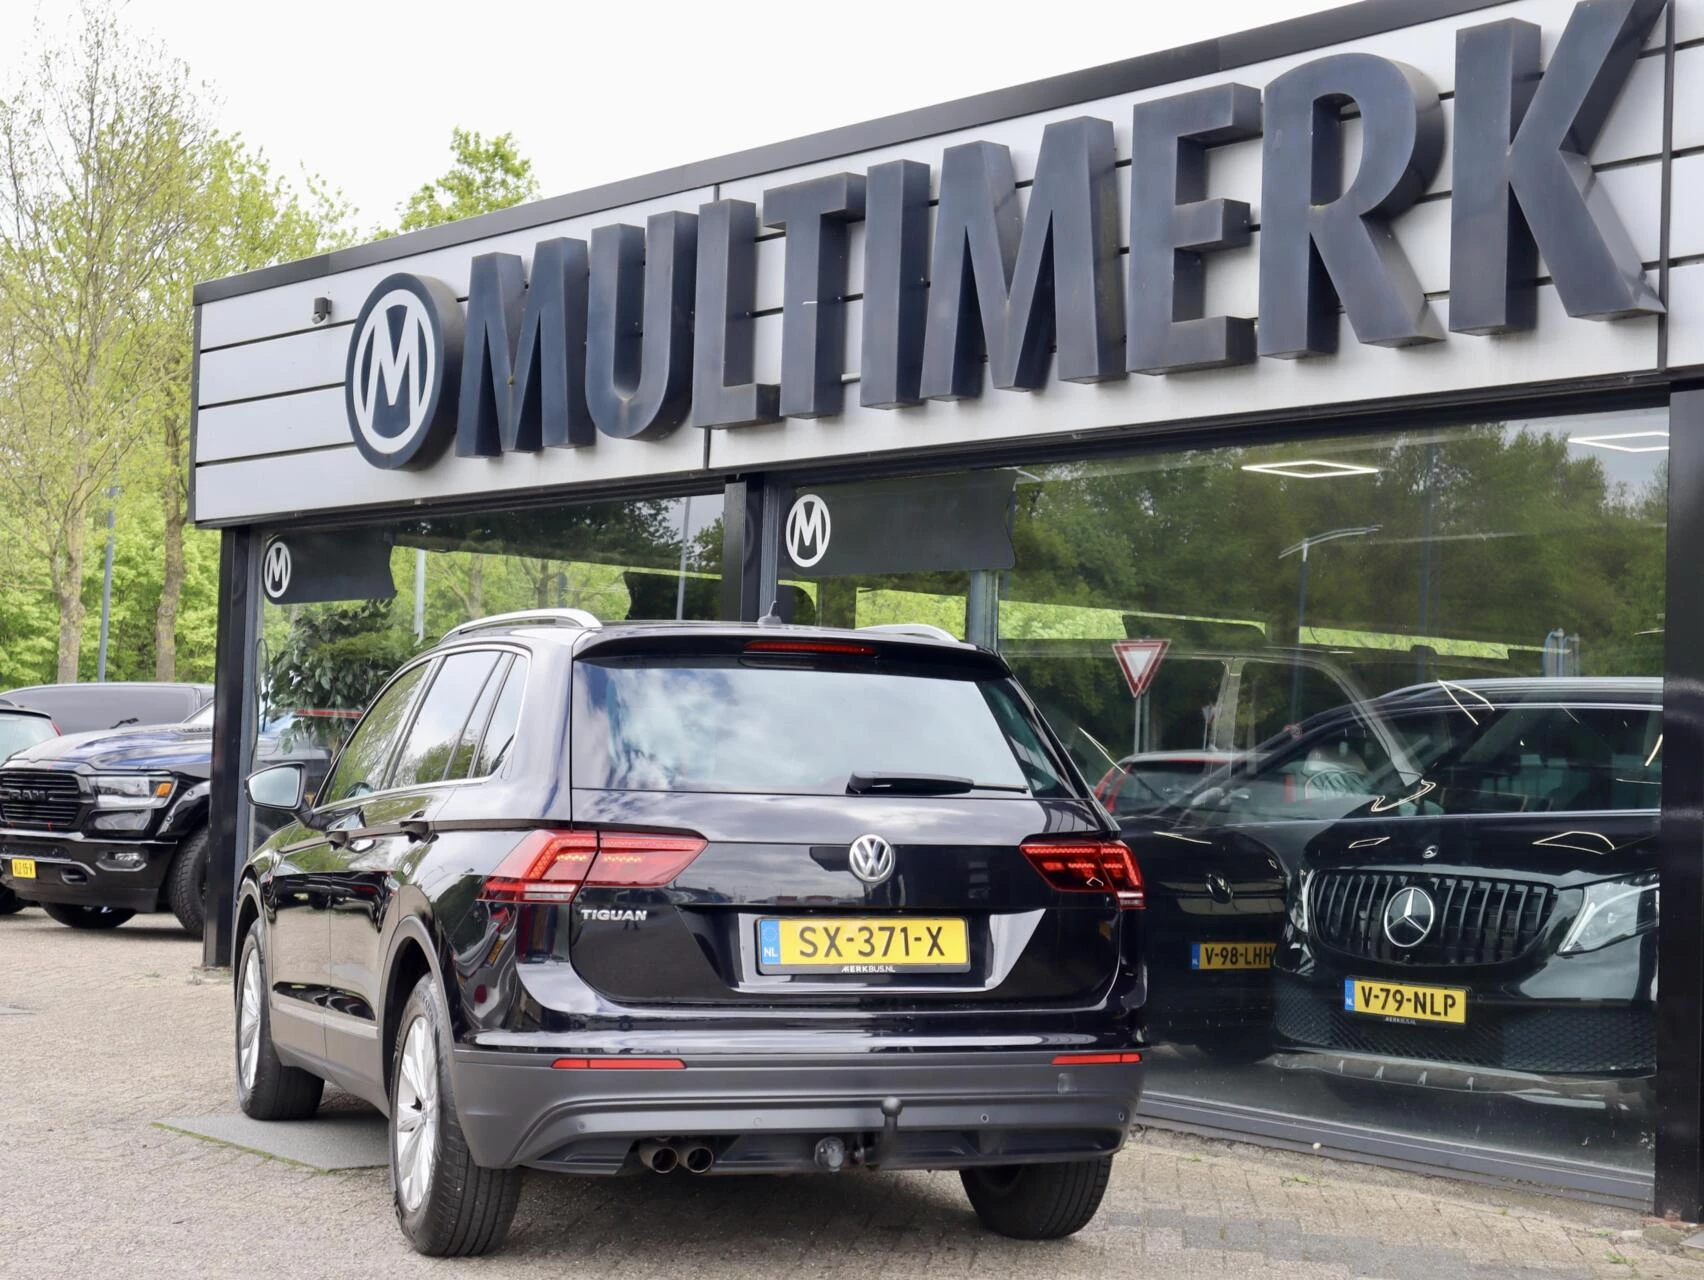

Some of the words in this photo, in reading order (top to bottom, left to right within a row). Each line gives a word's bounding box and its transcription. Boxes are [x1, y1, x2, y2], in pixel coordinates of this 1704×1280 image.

[455, 0, 1666, 458] MULTIMERK
[581, 909, 648, 921] TIGUAN
[763, 947, 779, 957] NL
[799, 925, 946, 958] SX-371-X
[1361, 985, 1456, 1017] V-79-NLP
